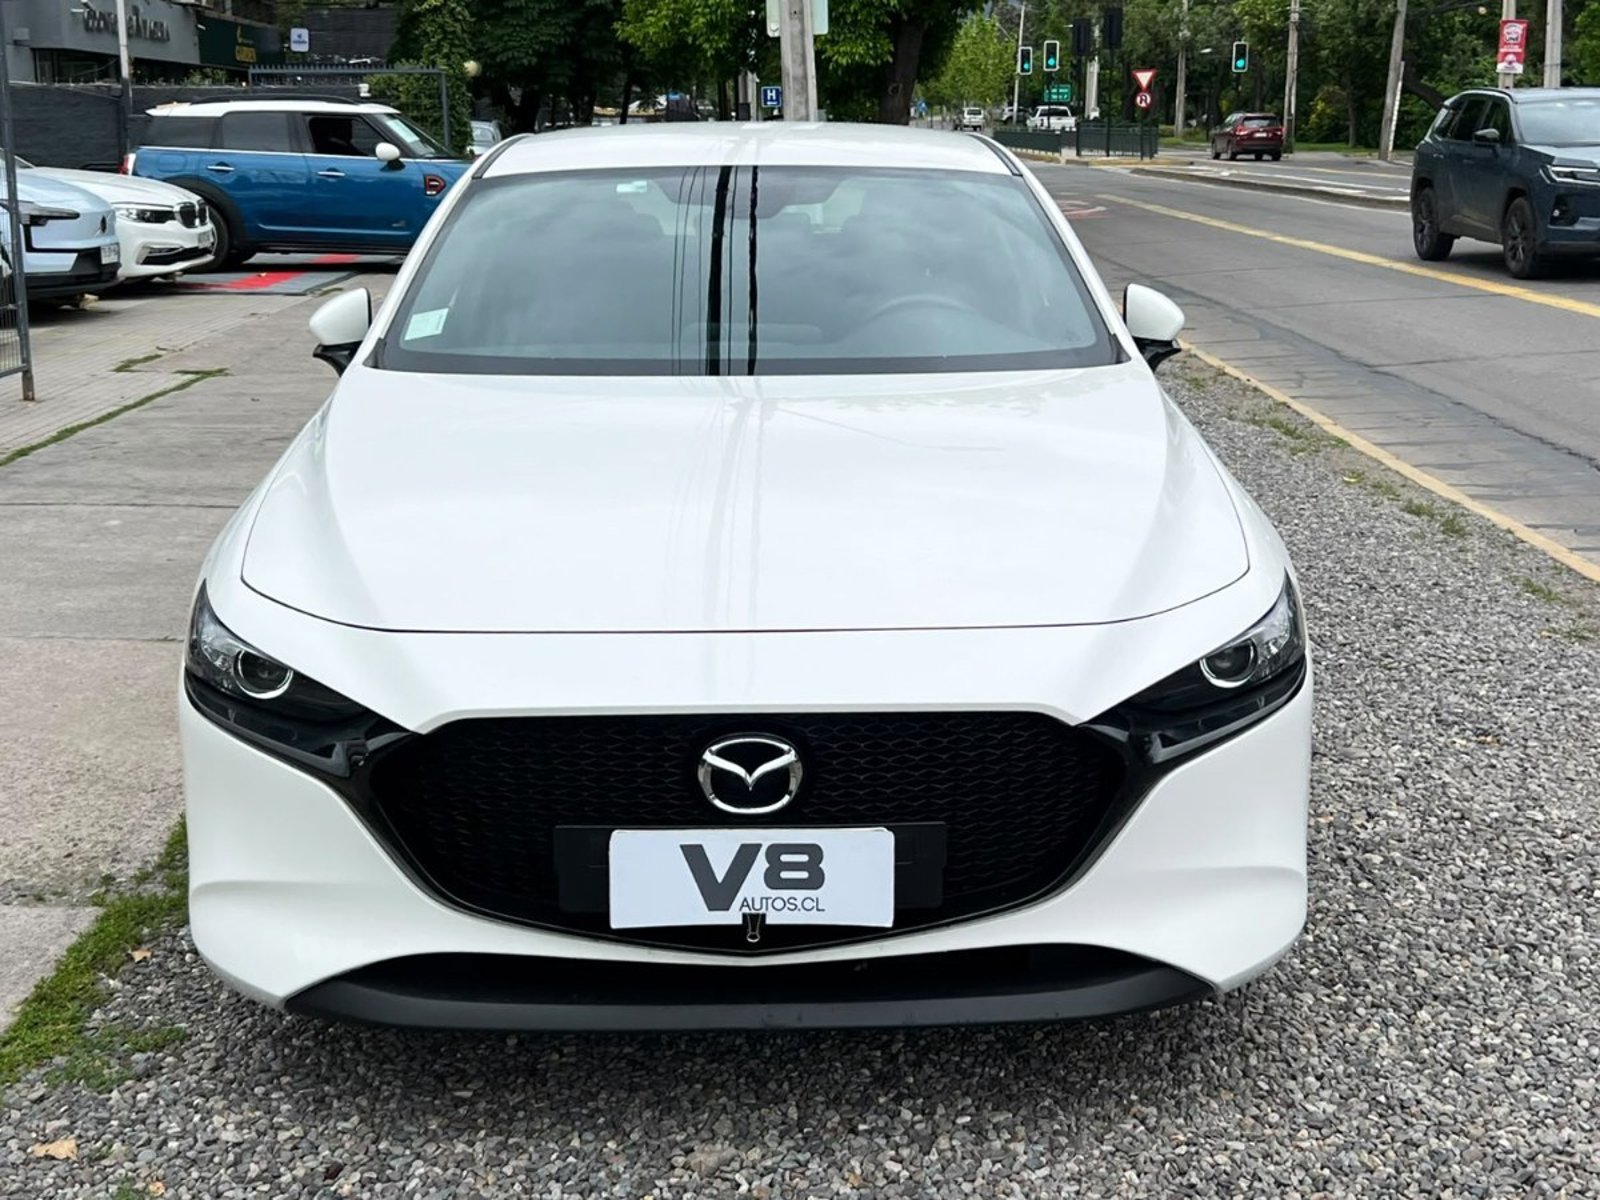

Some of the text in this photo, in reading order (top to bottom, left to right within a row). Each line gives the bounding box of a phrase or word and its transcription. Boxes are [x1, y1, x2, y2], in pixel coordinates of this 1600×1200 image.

[767, 89, 776, 100] H
[679, 843, 825, 911] V8
[739, 897, 825, 912] AUTOS.CL
